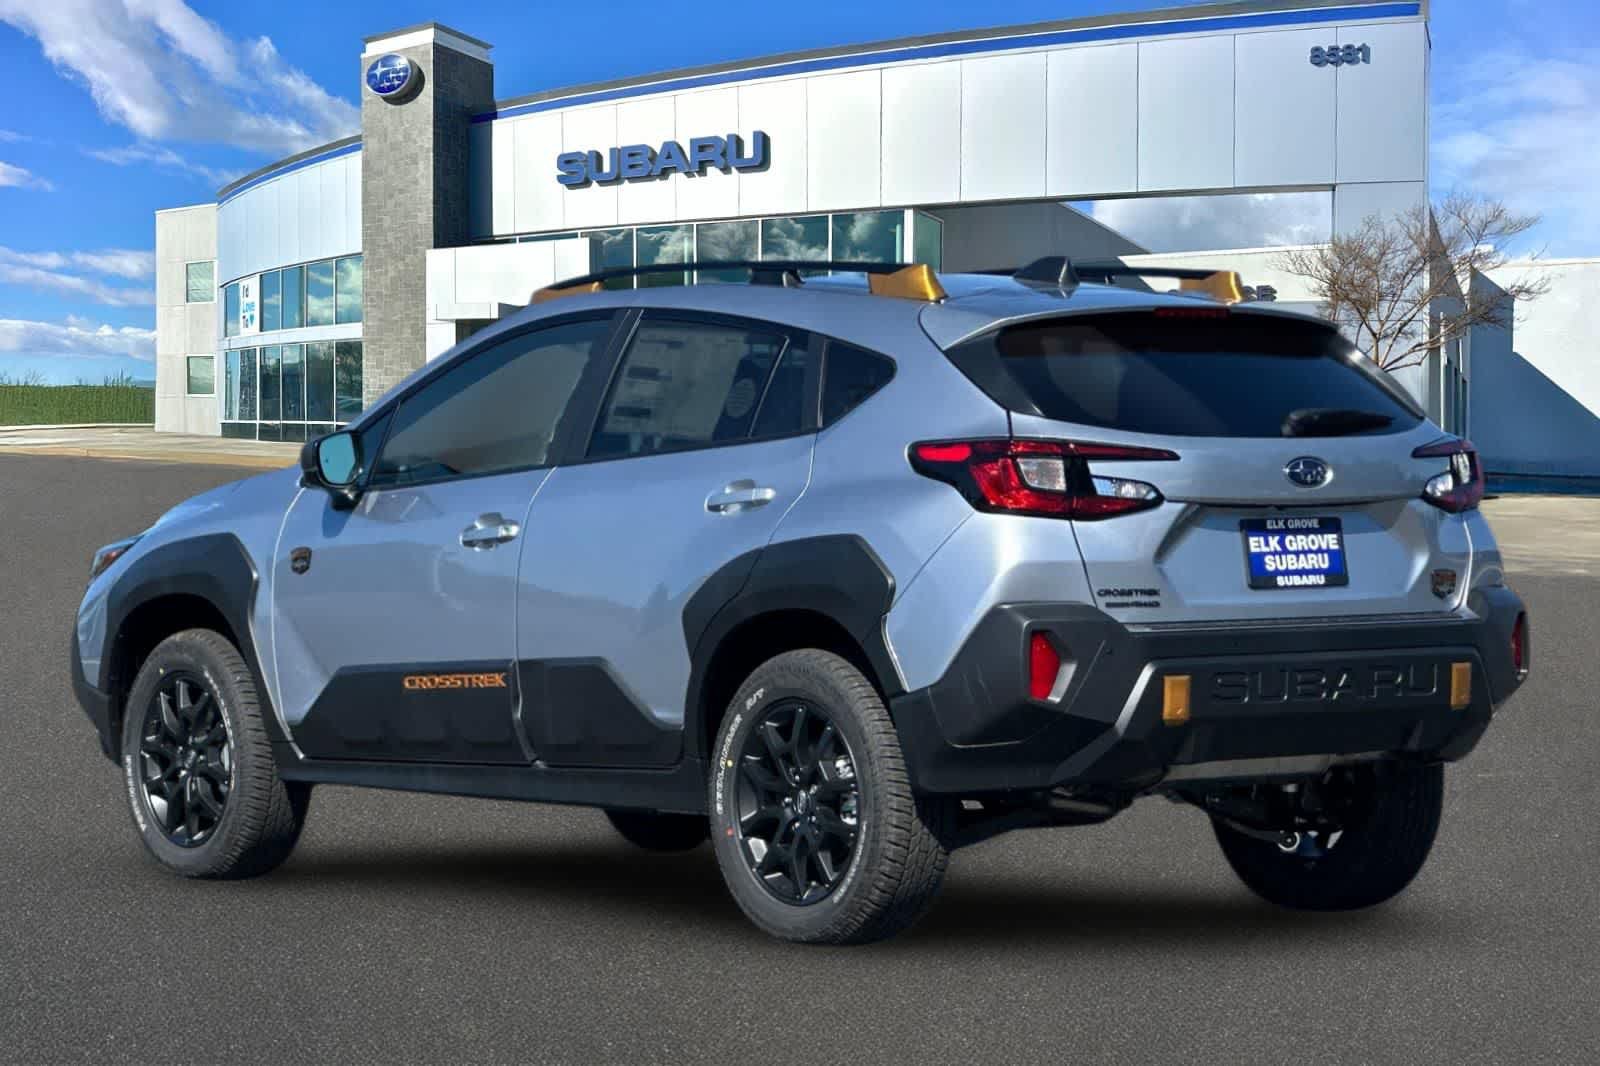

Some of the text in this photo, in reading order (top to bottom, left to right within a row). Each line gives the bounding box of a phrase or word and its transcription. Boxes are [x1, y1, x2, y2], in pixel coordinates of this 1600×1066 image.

[556, 130, 771, 190] SUBARU
[1266, 519, 1320, 529] ELK GROVE
[1249, 534, 1339, 552] ELK GROVE
[1264, 553, 1329, 571] SUBARU
[1276, 575, 1325, 586] SUBARU
[403, 673, 507, 689] CROSSTREK
[1211, 663, 1438, 703] SUBARU
